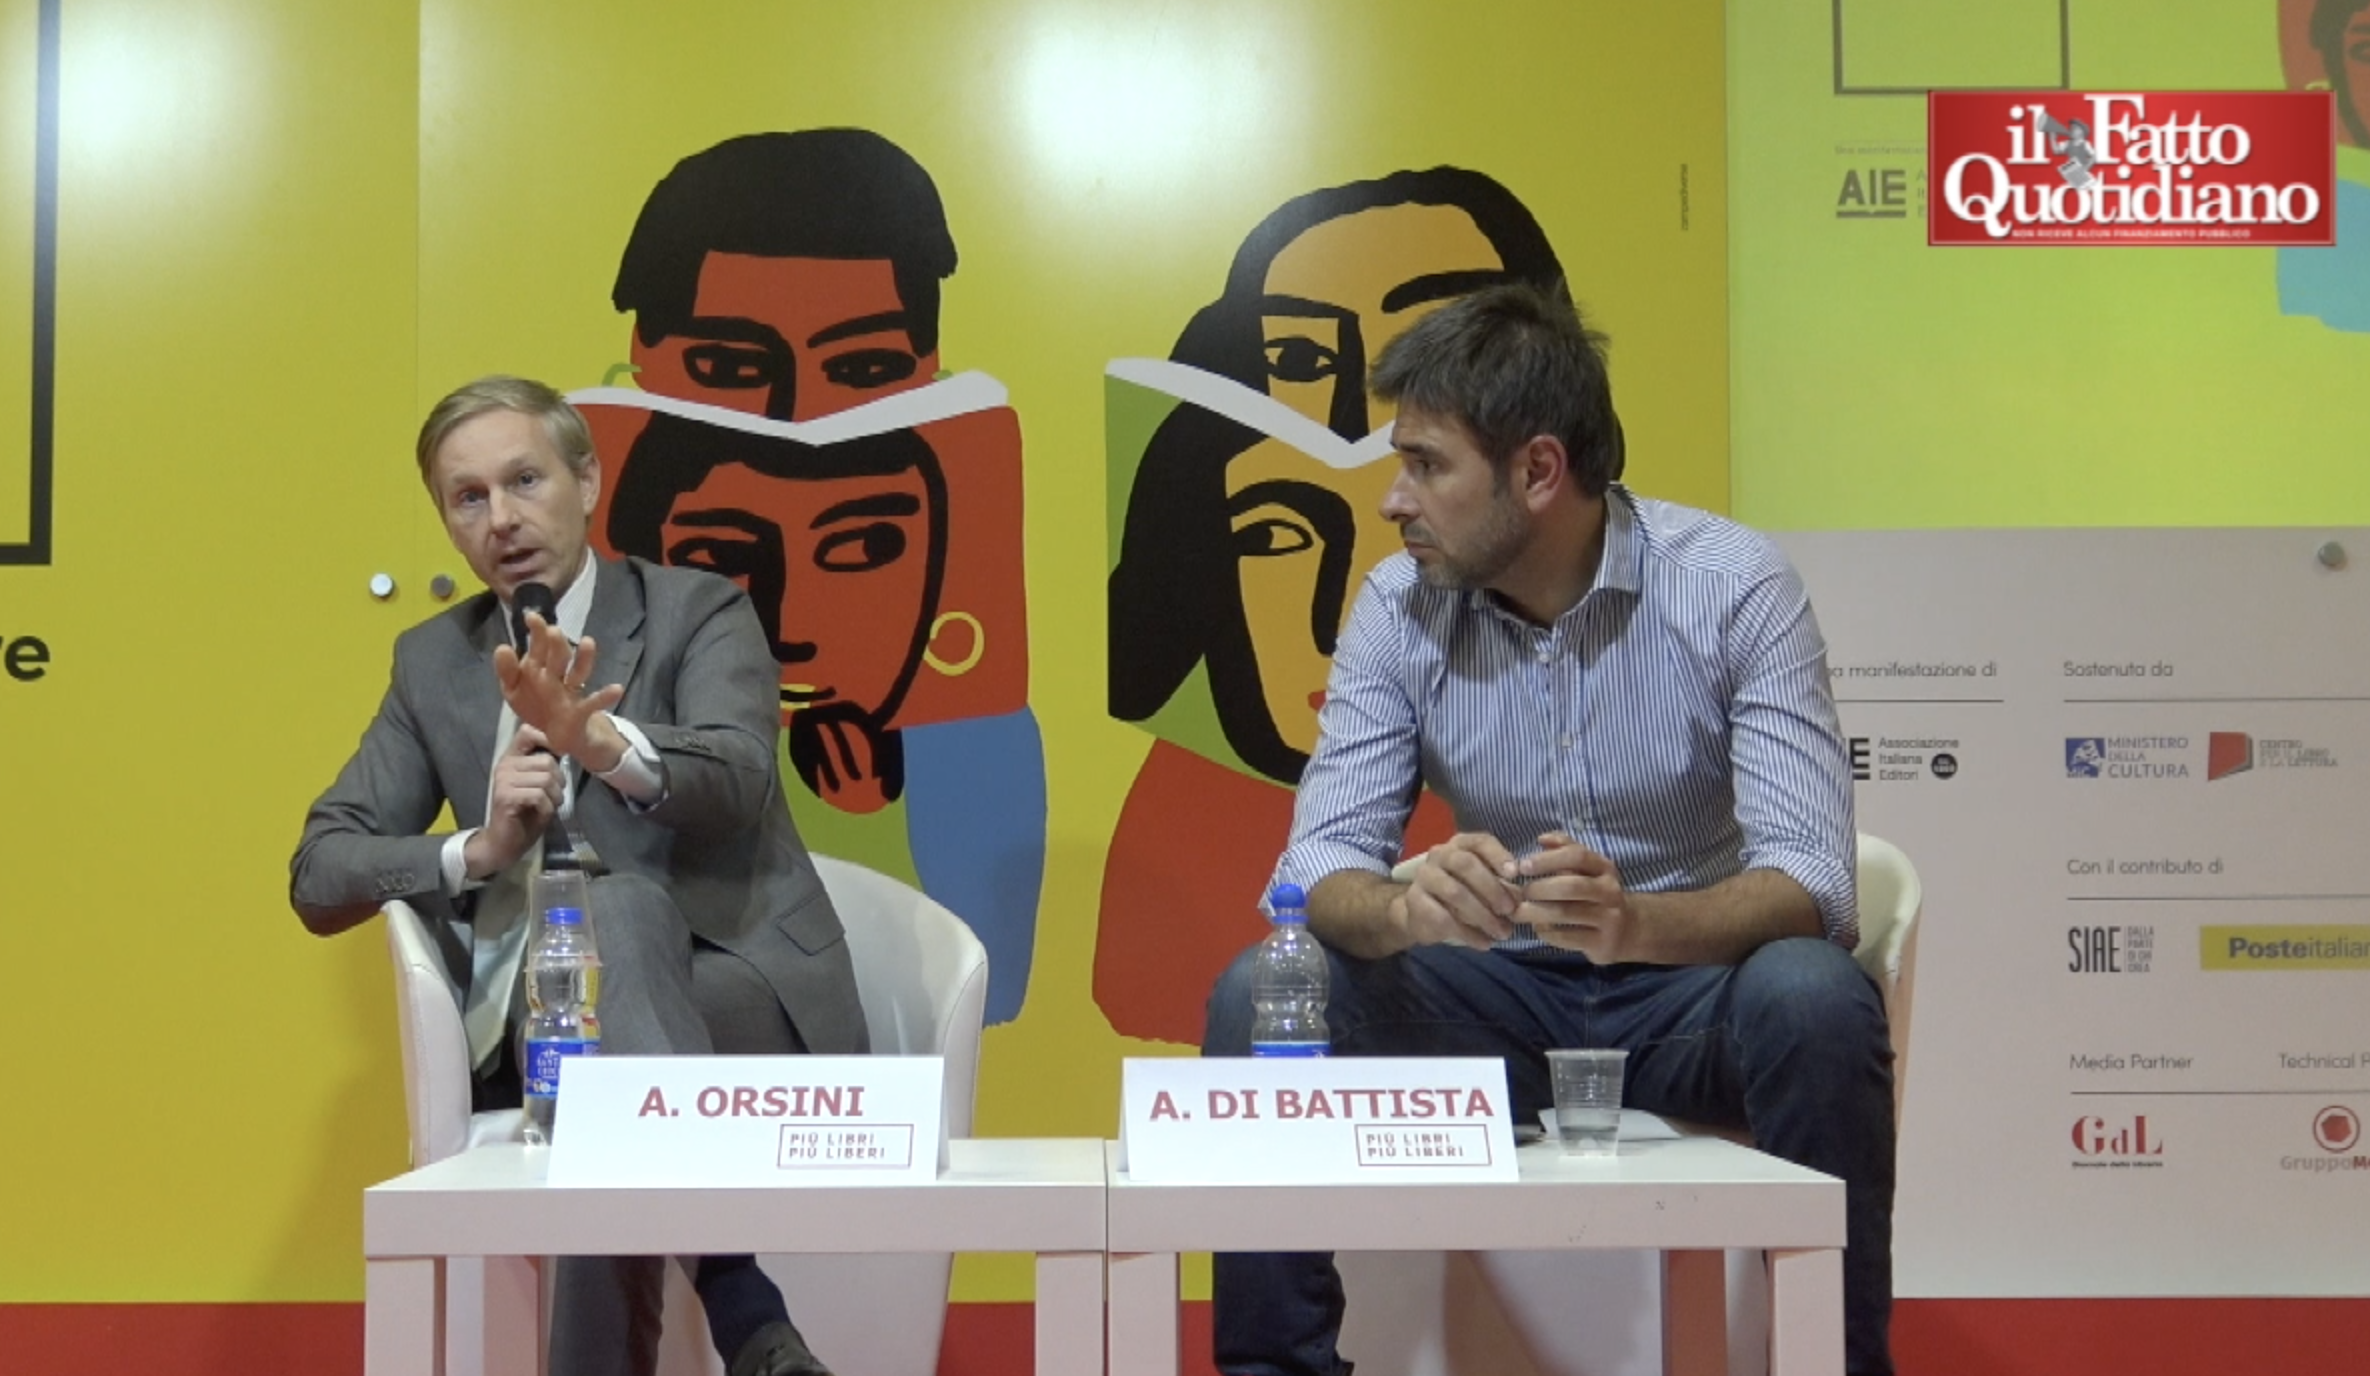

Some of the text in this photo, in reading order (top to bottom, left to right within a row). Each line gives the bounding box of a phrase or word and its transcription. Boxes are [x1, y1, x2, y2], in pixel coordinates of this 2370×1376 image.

[1837, 169, 1906, 205] AIE
[0, 635, 51, 682] e
[1850, 661, 1976, 677] manifestazione
[1982, 661, 1997, 677] di
[2063, 660, 2173, 677] Sostenuta da
[1878, 737, 1960, 749] Associazione
[2107, 737, 2189, 749] MINISTERO
[1879, 753, 1923, 765] Italiana
[2108, 750, 2147, 762] DELLA
[1879, 769, 1919, 781] Editori
[2107, 763, 2189, 779] CULTURA
[2066, 858, 2224, 875] Con il contributo di
[2068, 926, 2121, 973] SIAE
[2069, 1053, 2194, 1070] Media Partner
[2279, 1052, 2356, 1069] Technical
[638, 1085, 865, 1118] A. ORSINI
[1149, 1088, 1494, 1120] A. DI BATTISTA
[827, 1132, 874, 1146] LIBRI
[1403, 1132, 1450, 1146] LIBRI
[2071, 1115, 2163, 1156] GdL
[826, 1147, 885, 1159] LIBERI
[1405, 1146, 1464, 1158] LIBERI
